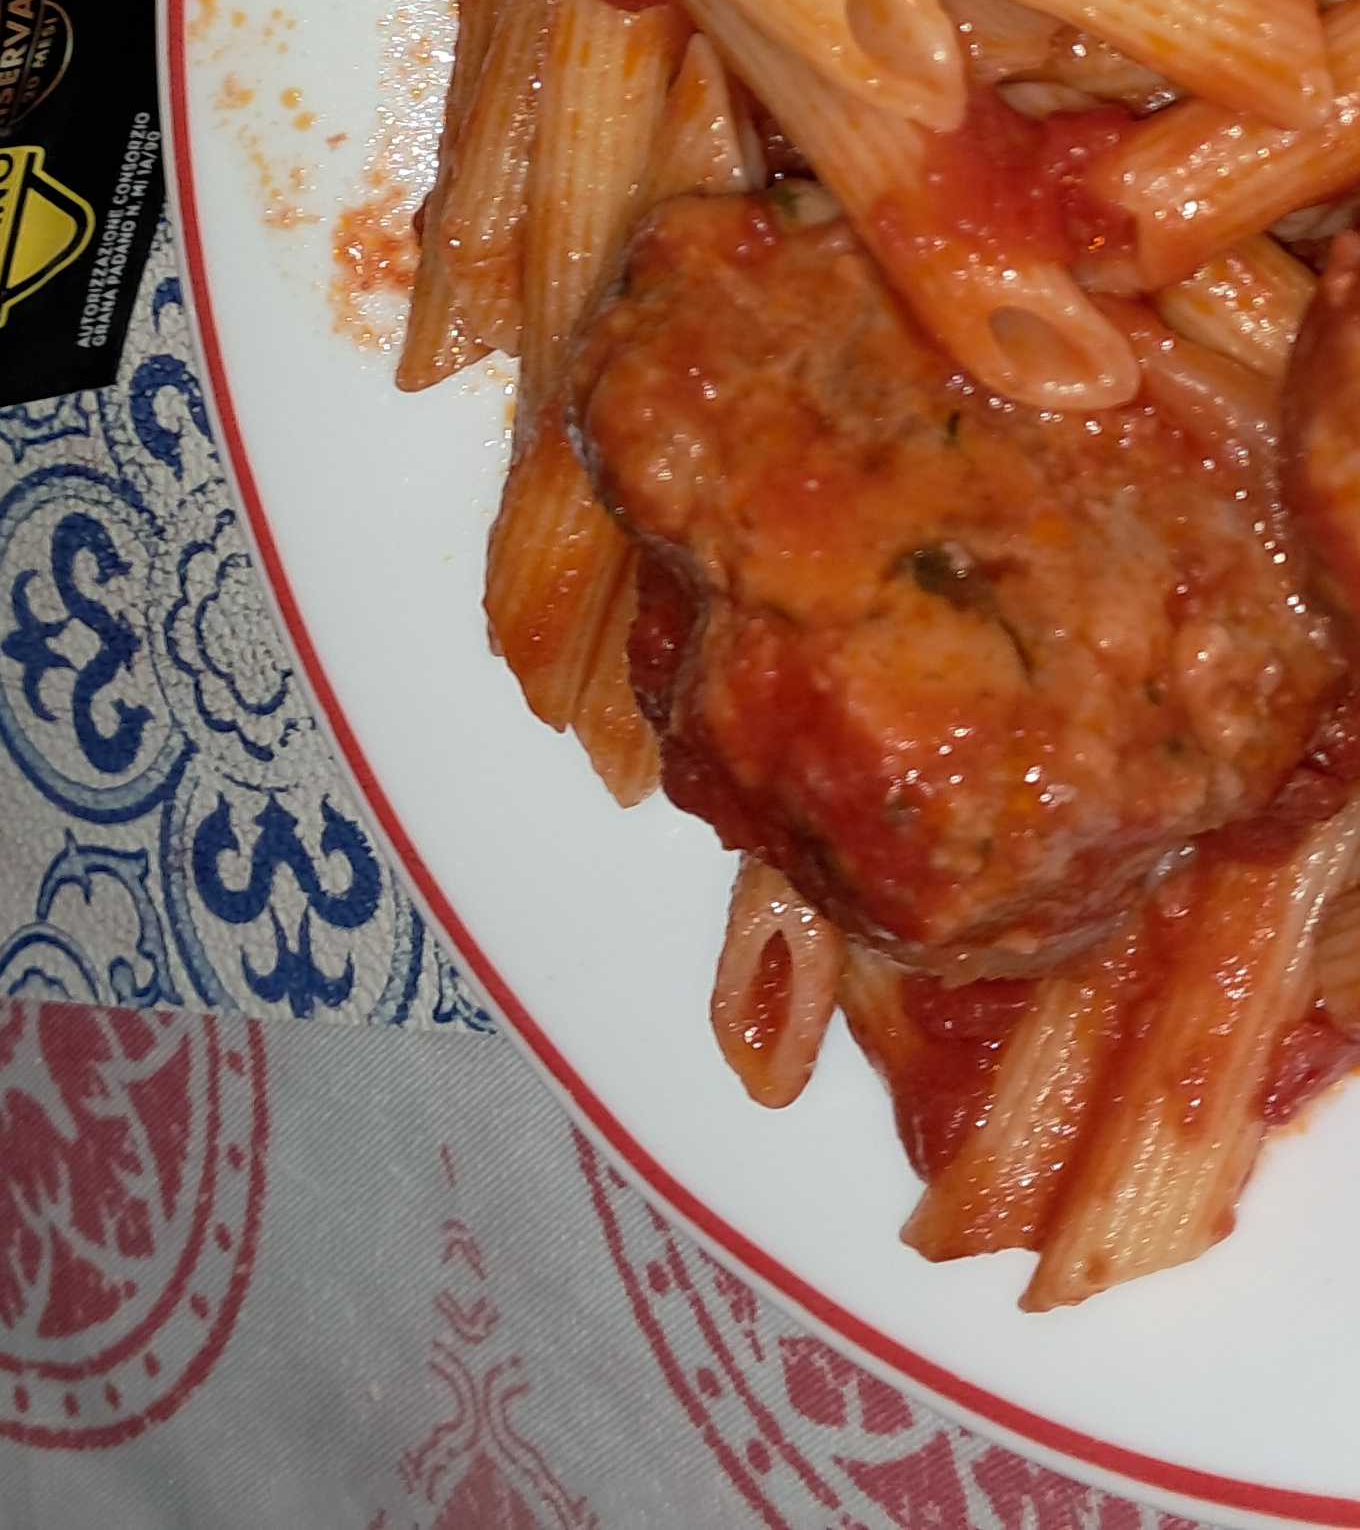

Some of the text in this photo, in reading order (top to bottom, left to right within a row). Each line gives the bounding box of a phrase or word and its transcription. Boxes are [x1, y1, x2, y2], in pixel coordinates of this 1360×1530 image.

[76, 111, 150, 348] AUTORIZZAZIONE CONSORZIO
[92, 288, 120, 347] GRANA
[107, 220, 138, 285] PADANO
